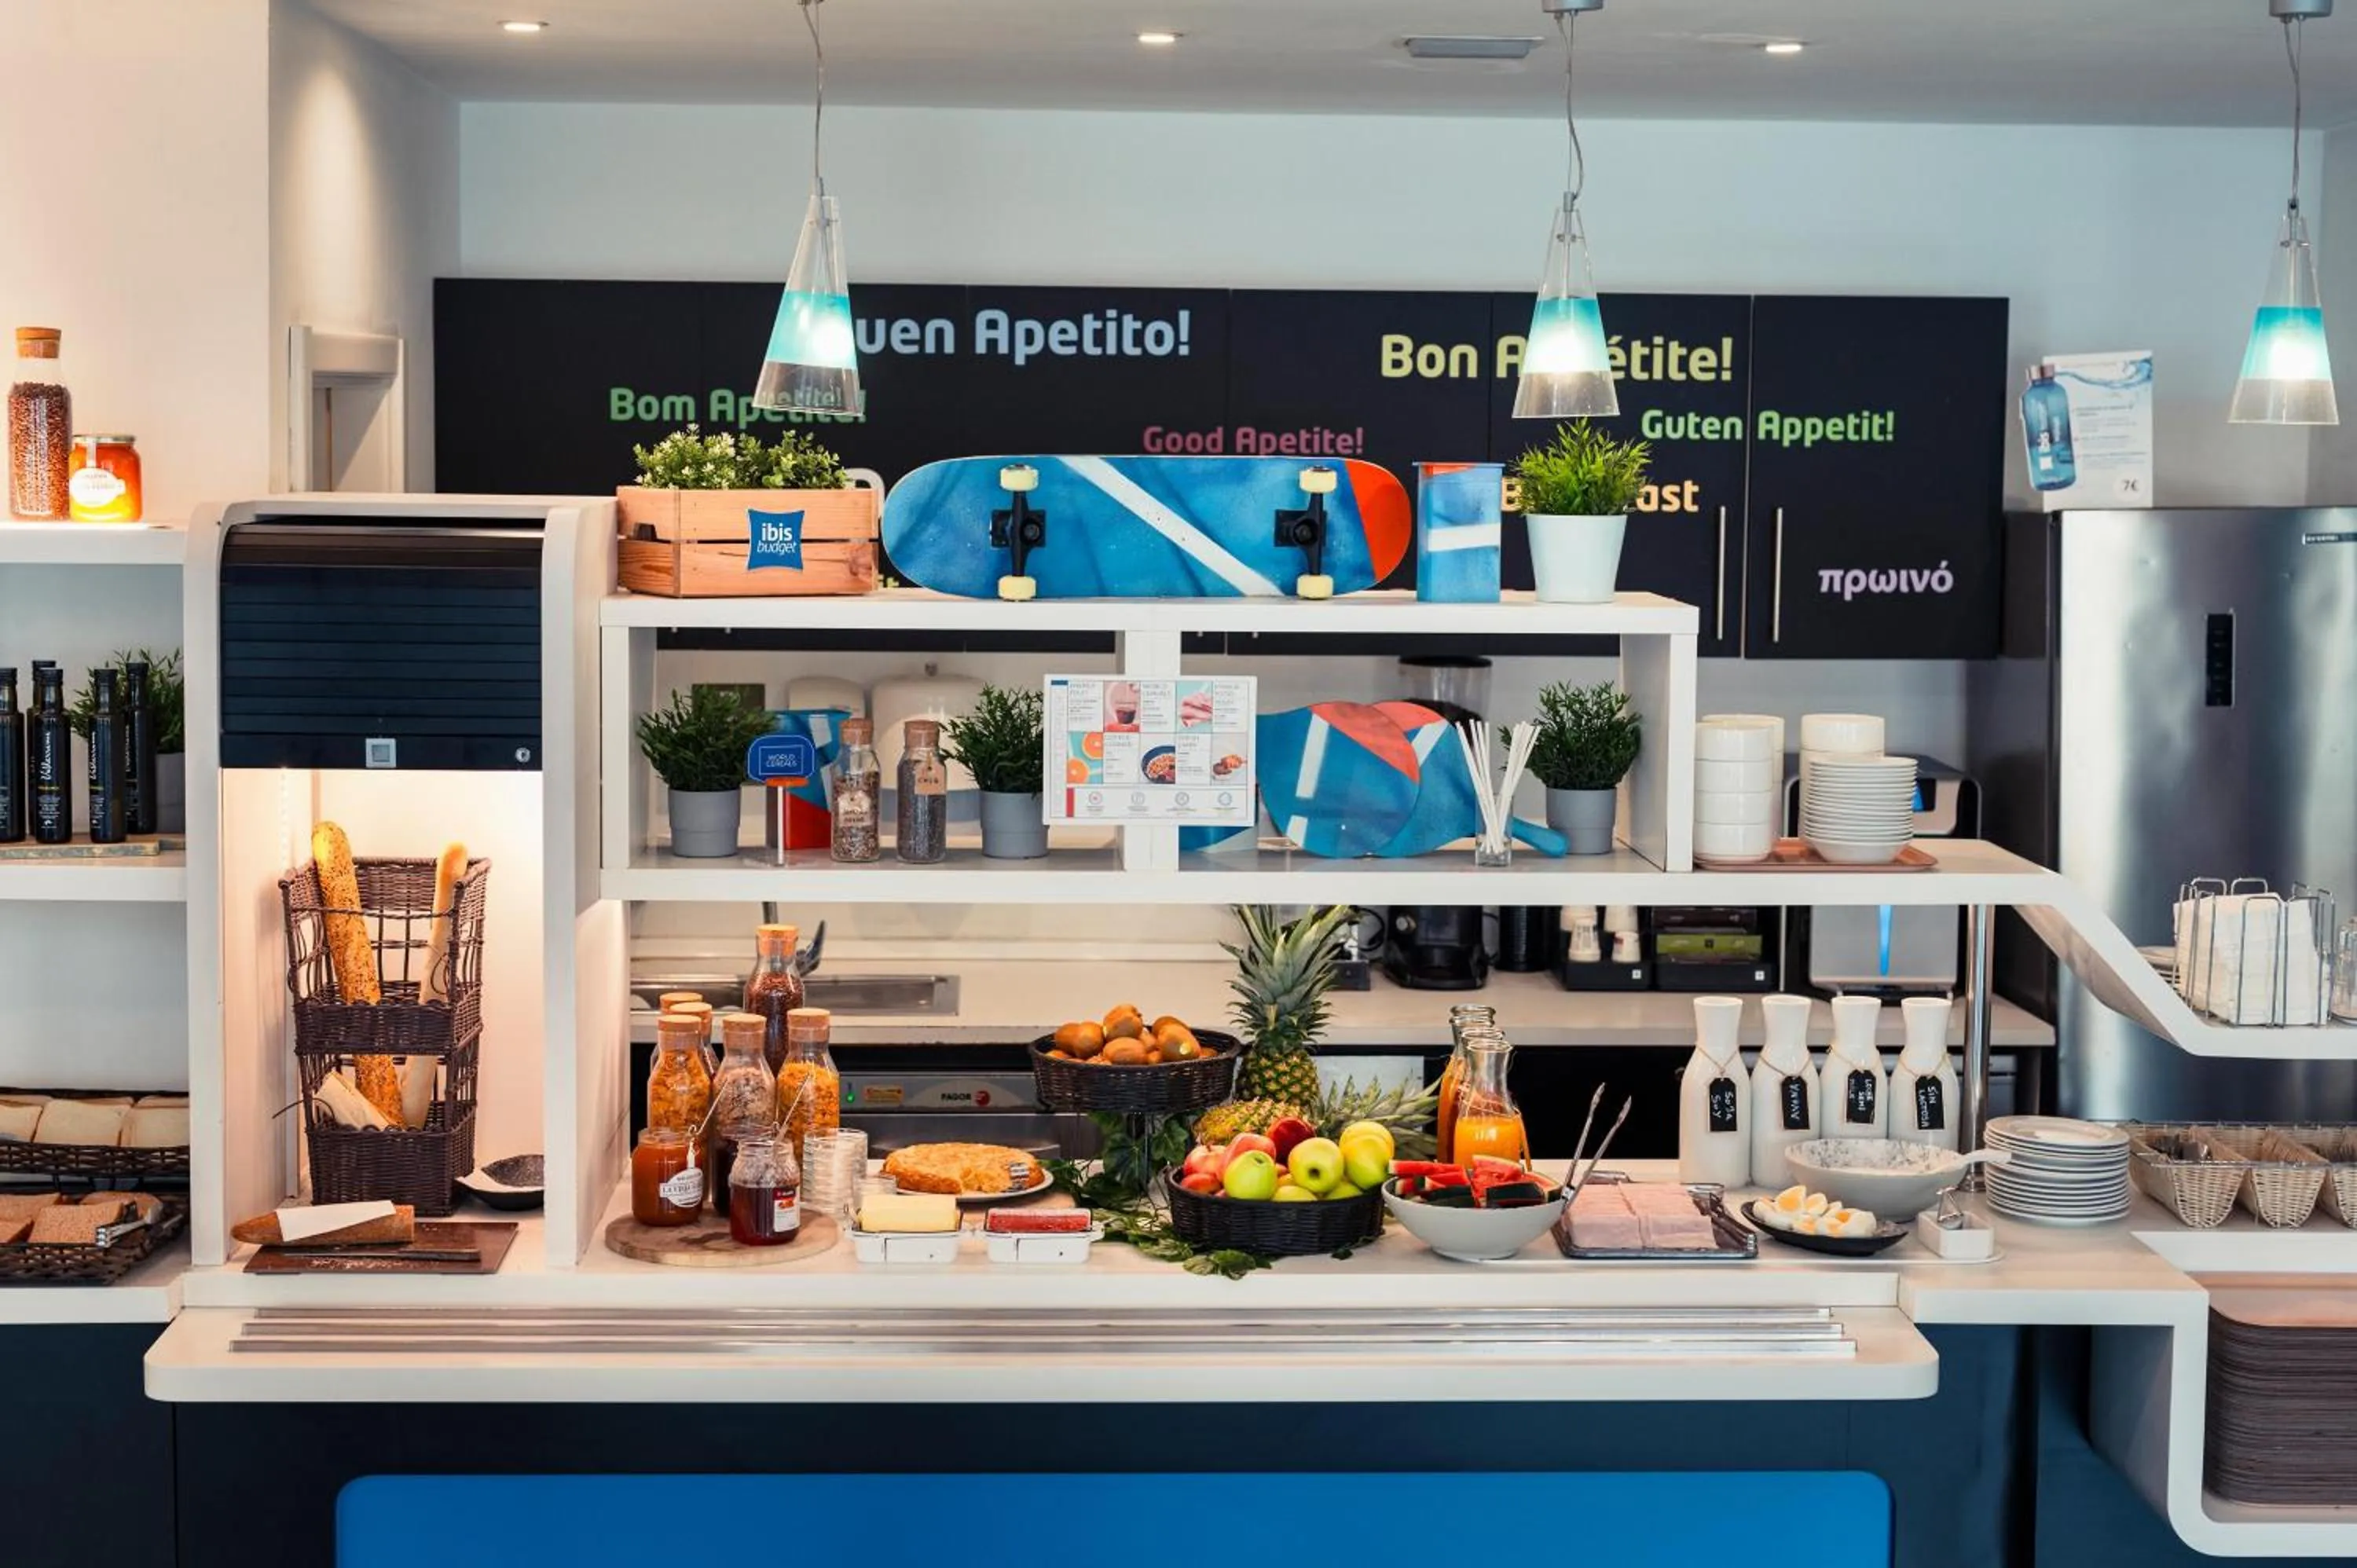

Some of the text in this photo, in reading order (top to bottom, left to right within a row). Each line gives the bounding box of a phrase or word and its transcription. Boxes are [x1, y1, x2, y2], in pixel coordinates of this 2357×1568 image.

[856, 309, 1190, 365] uen Apetito!
[1380, 334, 1733, 381] Bon Aétite!
[610, 387, 695, 422] Bom
[1143, 427, 1363, 456] Good Apetite!
[1641, 409, 1895, 447] Guten Appetit!
[757, 540, 797, 555] budget
[761, 522, 793, 541] ibis
[1818, 560, 1954, 601] πρωινό
[1927, 1086, 1938, 1104] SIN
